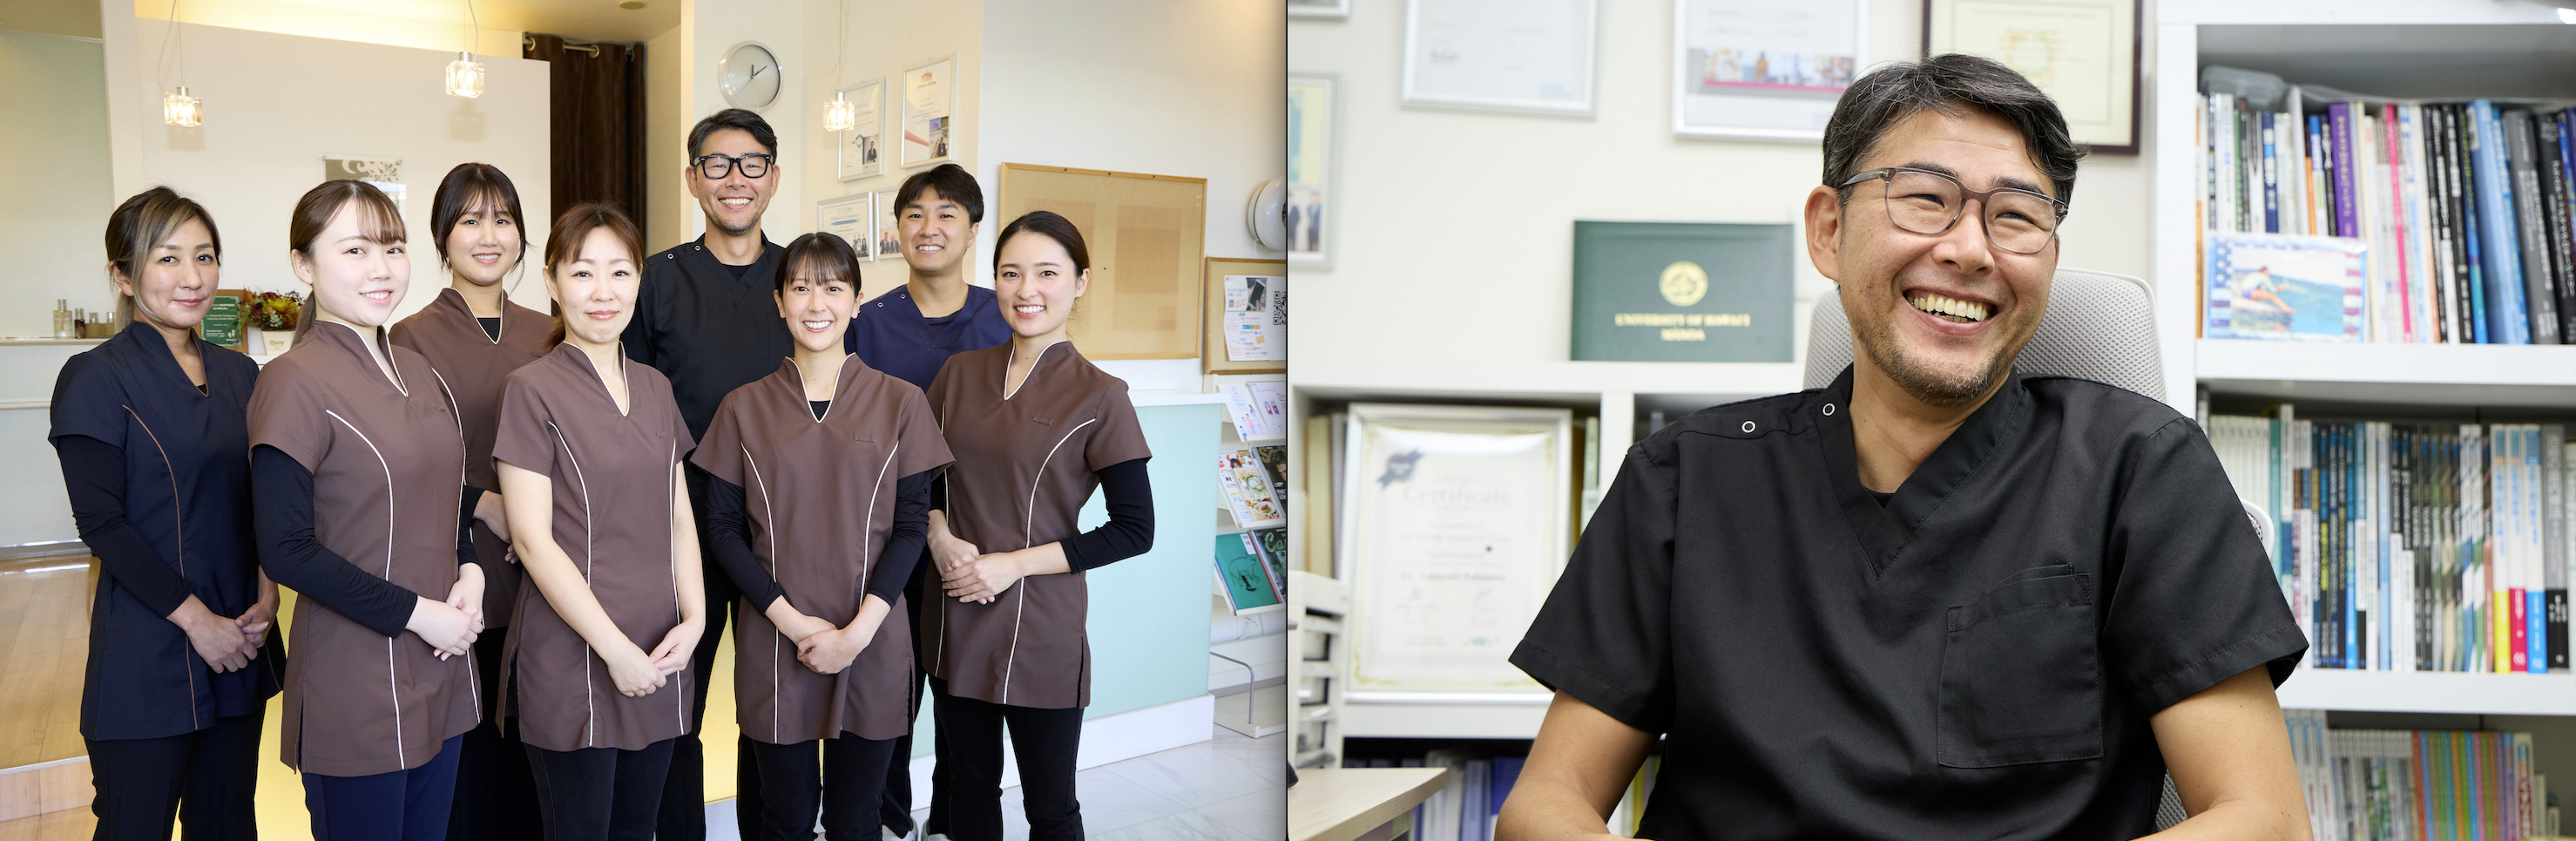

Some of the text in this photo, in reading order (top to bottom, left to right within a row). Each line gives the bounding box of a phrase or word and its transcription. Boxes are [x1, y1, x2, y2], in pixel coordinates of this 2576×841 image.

[1615, 313, 1685, 327] UNIVERSITY
[1686, 314, 1703, 327] OF
[1264, 532, 1286, 553] Ca
